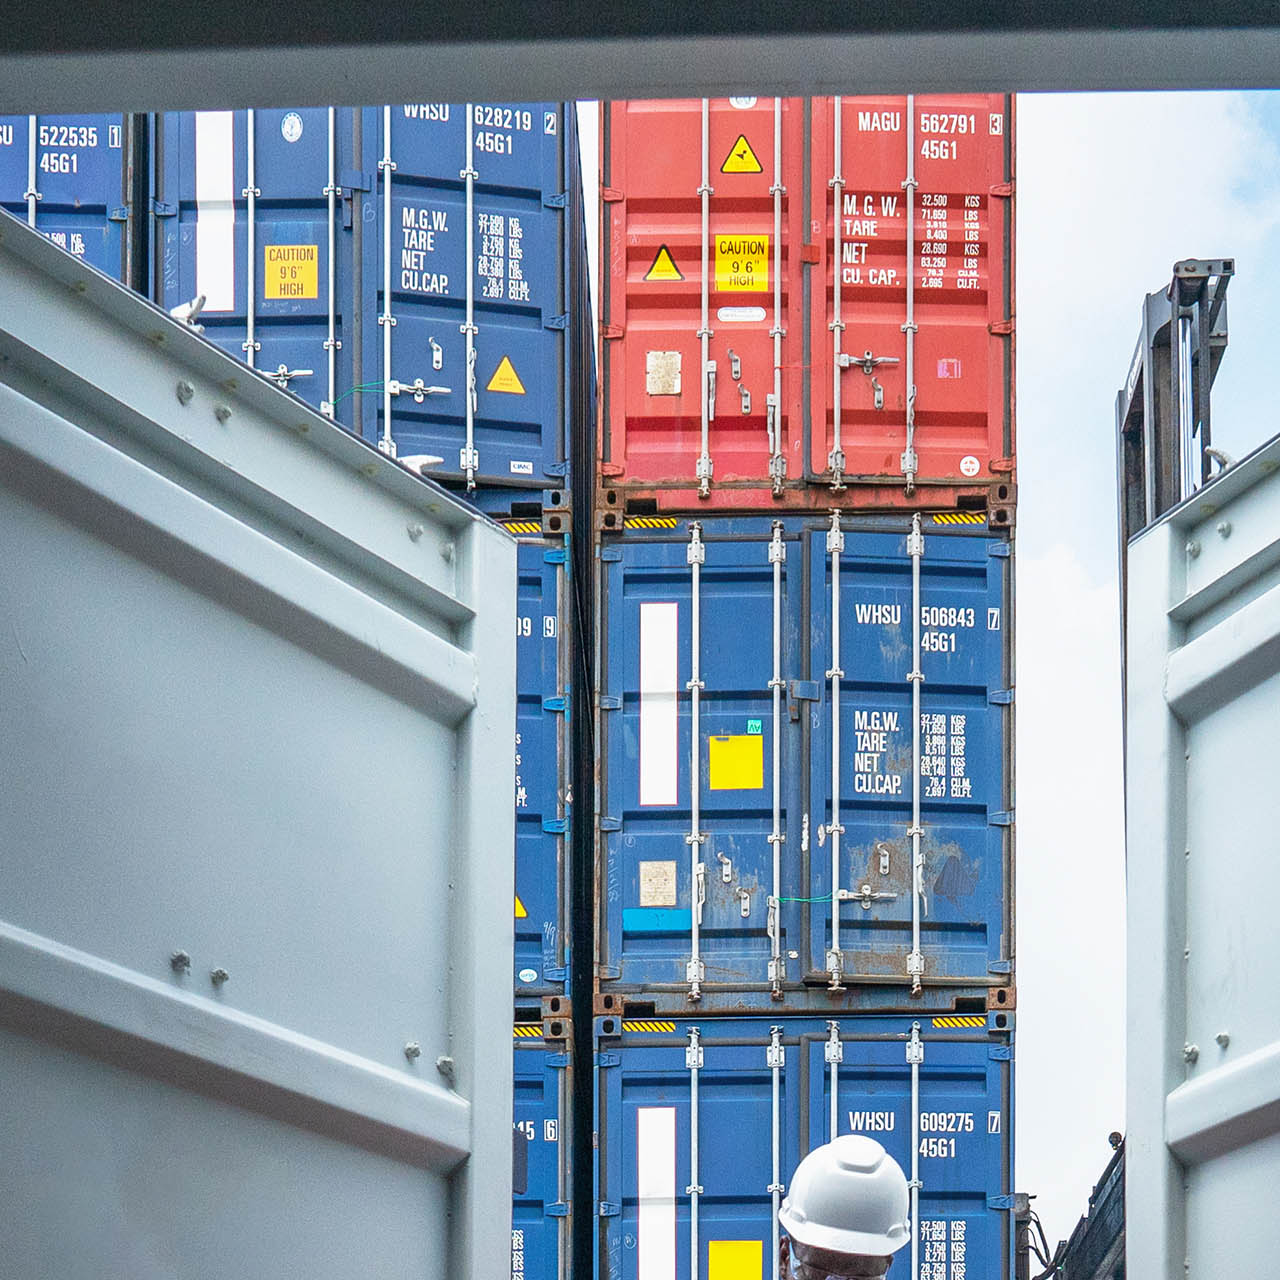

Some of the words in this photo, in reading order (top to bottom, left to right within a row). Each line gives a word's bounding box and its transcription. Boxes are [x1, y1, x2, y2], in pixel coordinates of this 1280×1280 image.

[403, 104, 449, 122] WHSU
[474, 106, 532, 131] 628219
[858, 112, 900, 132] MAGU
[920, 114, 976, 134] 562791
[40, 126, 98, 146] 522535
[475, 132, 512, 154] 45G1
[920, 140, 957, 160] 45G1
[40, 152, 78, 173] 45G1
[964, 196, 980, 208] KGS
[402, 207, 448, 232] M.G.W.
[964, 210, 978, 221] LBS
[844, 220, 878, 236] TARE
[402, 228, 435, 251] TARE
[720, 241, 764, 255] CAUTION
[269, 248, 314, 262] CAUTION
[402, 249, 426, 270] NET
[842, 242, 868, 264] NET
[964, 244, 980, 256] KGS
[401, 270, 449, 294] CU.CAP.
[730, 276, 754, 286] HIGH
[842, 268, 864, 284] CU.
[868, 269, 900, 286] CAP.
[956, 278, 980, 289] CU.FT.
[280, 282, 304, 296] HIGH
[855, 604, 901, 624] WHSU
[921, 606, 975, 628] 506843
[921, 632, 956, 652] 45G1
[854, 710, 900, 732] M.G.W.
[855, 732, 888, 752] TARE
[854, 752, 880, 772] NET
[854, 774, 902, 794] CU.CAP.
[848, 1112, 894, 1131] WHSU
[920, 1113, 974, 1132] 609275
[920, 1138, 956, 1158] 45G1
